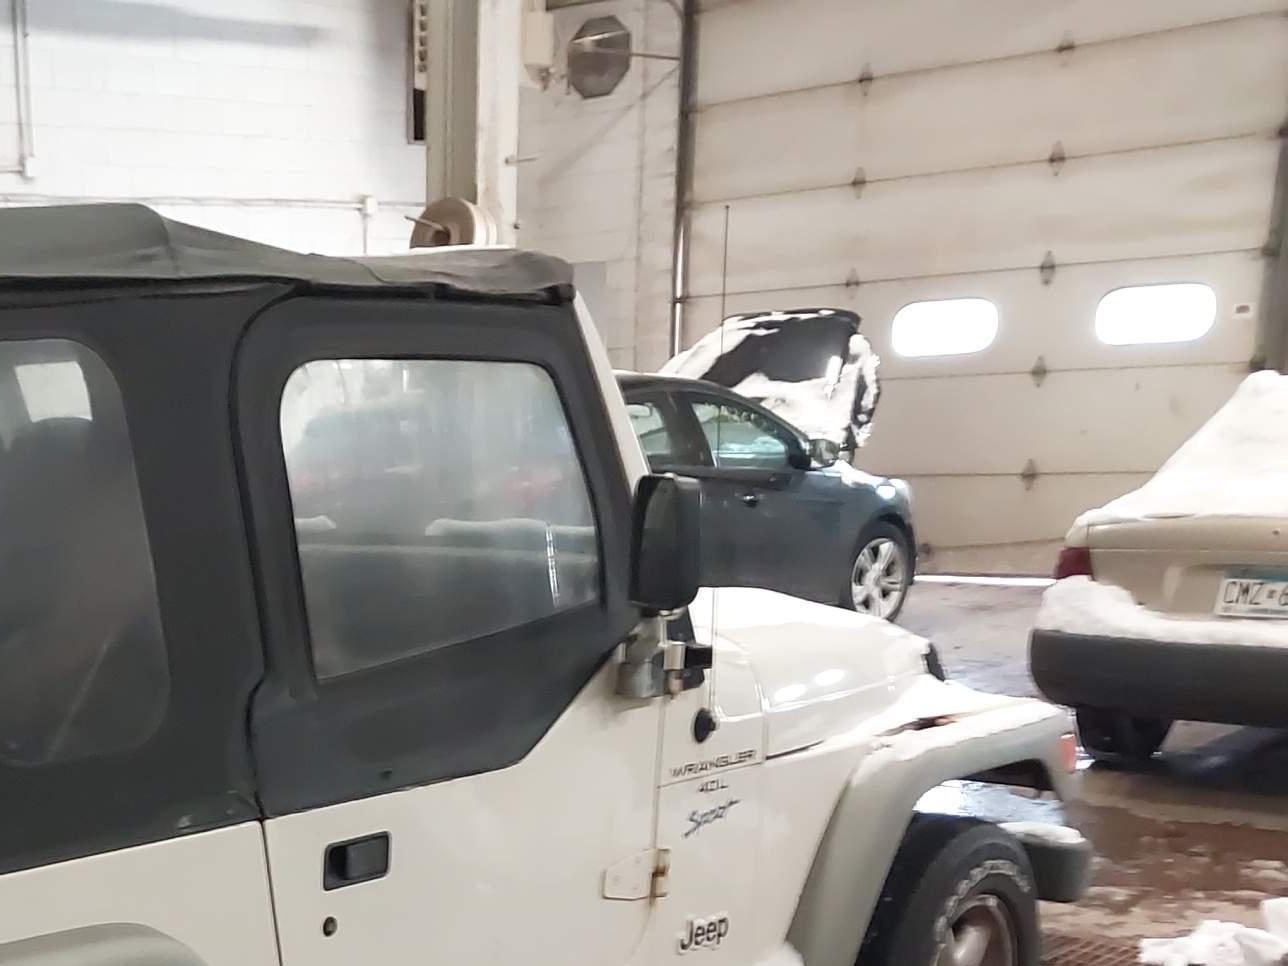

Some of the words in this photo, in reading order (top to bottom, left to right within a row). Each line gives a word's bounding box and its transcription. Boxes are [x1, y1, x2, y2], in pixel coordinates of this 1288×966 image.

[1223, 581, 1265, 605] CMZ
[670, 749, 756, 777] WRANGLER
[680, 916, 729, 951] Jeep
